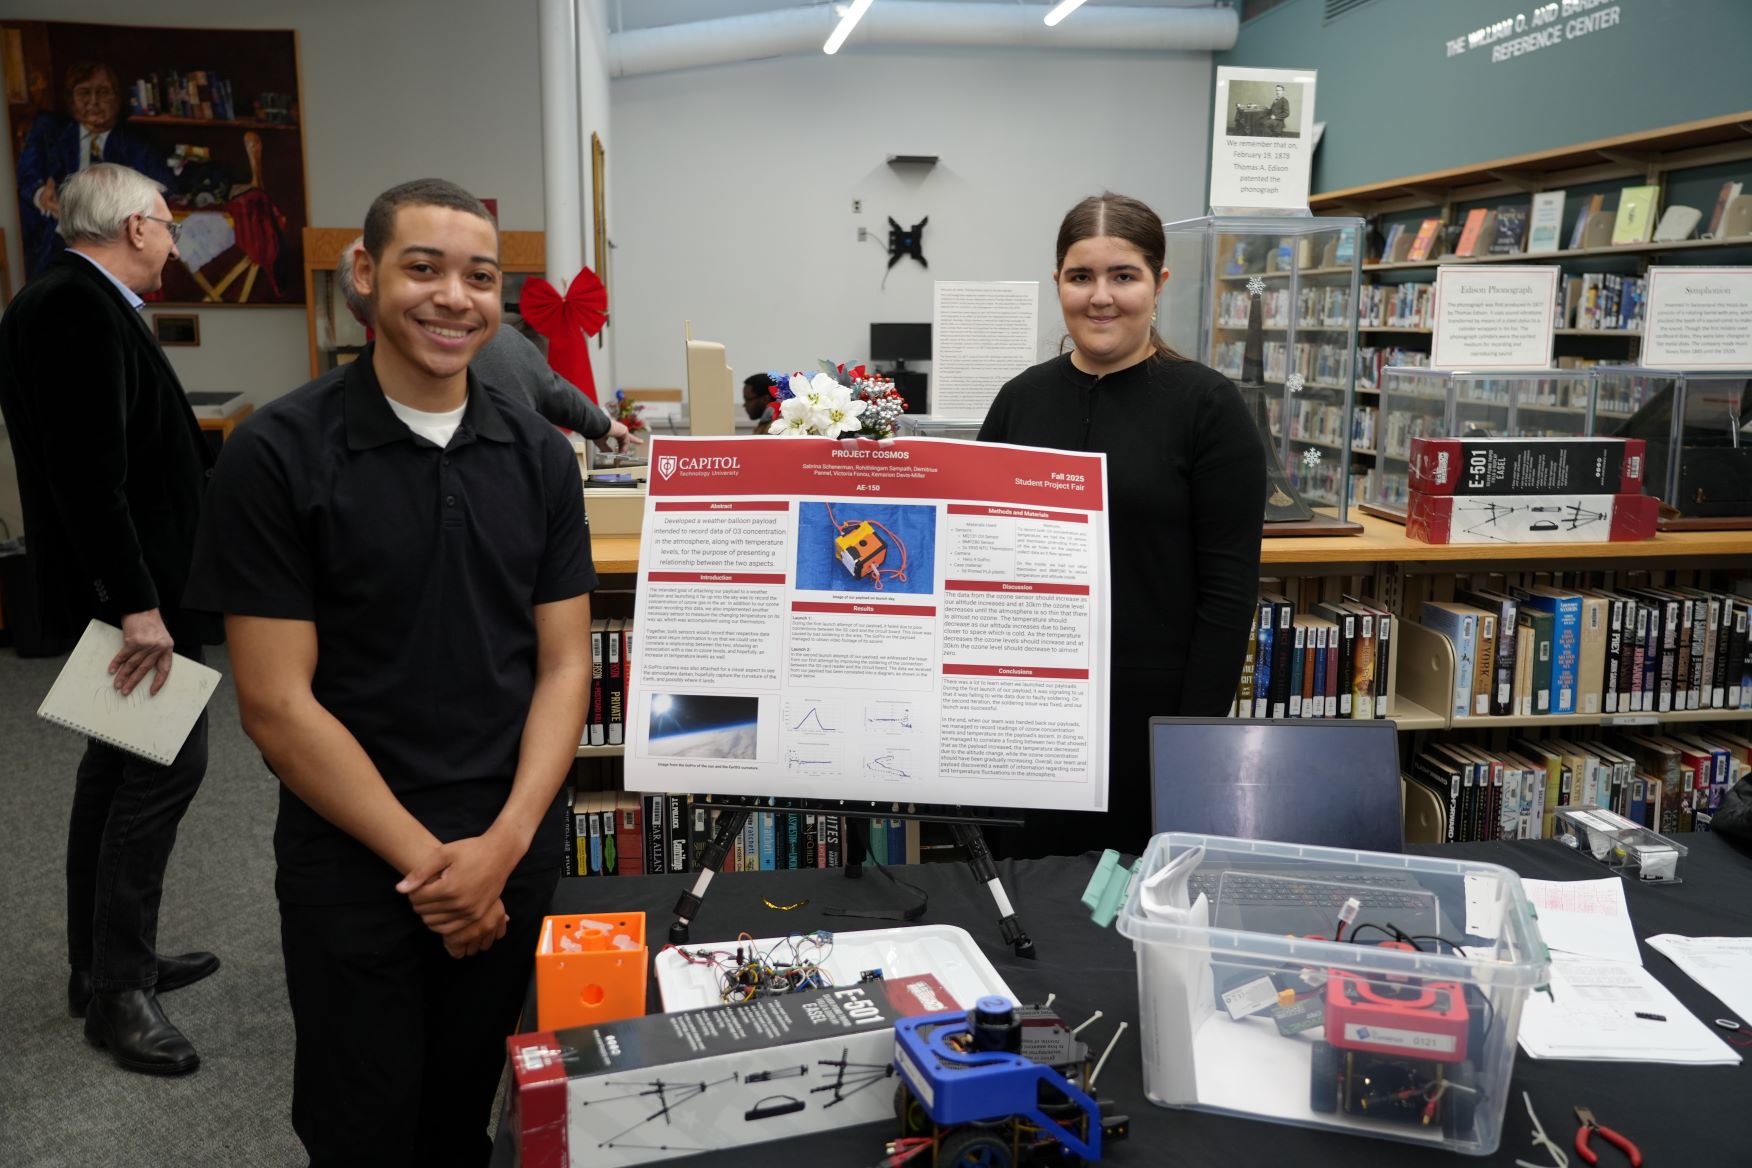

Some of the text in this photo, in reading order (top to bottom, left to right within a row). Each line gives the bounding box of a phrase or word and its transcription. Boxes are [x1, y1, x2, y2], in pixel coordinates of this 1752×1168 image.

[1446, 36, 1466, 57] THE
[1531, 3, 1559, 27] AND
[1492, 6, 1620, 62] REFERENCE CENTER
[1233, 151, 1261, 159] February
[1240, 186, 1278, 194] phonograph
[1461, 285, 1533, 295] Edison Phonograph
[679, 456, 740, 470] CAPITOL
[832, 450, 909, 460] PROJECT COSMOS
[1051, 473, 1085, 482] Fall 2025
[1468, 450, 1486, 488] E-501
[1497, 457, 1506, 480] EASEL
[856, 484, 880, 492] AE-150
[1015, 478, 1085, 491] Student Project Fair
[664, 518, 696, 526] Developed
[751, 518, 777, 526] payload
[988, 508, 1012, 516] Methods
[672, 538, 710, 546] atmosphere,
[744, 539, 784, 547] temperature
[659, 559, 695, 567] relationship
[736, 549, 770, 557] presenting
[1695, 601, 1708, 620] JOHN
[1610, 633, 1621, 655] PREY
[1692, 621, 1706, 656] SANDFORD
[1480, 648, 1492, 677] YORK
[1631, 647, 1645, 691] JOHN SANDFO
[610, 691, 620, 722] PRIVATE
[654, 842, 662, 872] ALLAN
[671, 838, 686, 871] Centrifuge
[806, 841, 814, 864] CHILD
[802, 1002, 827, 1025] EASEL
[834, 988, 885, 1025] E-501
